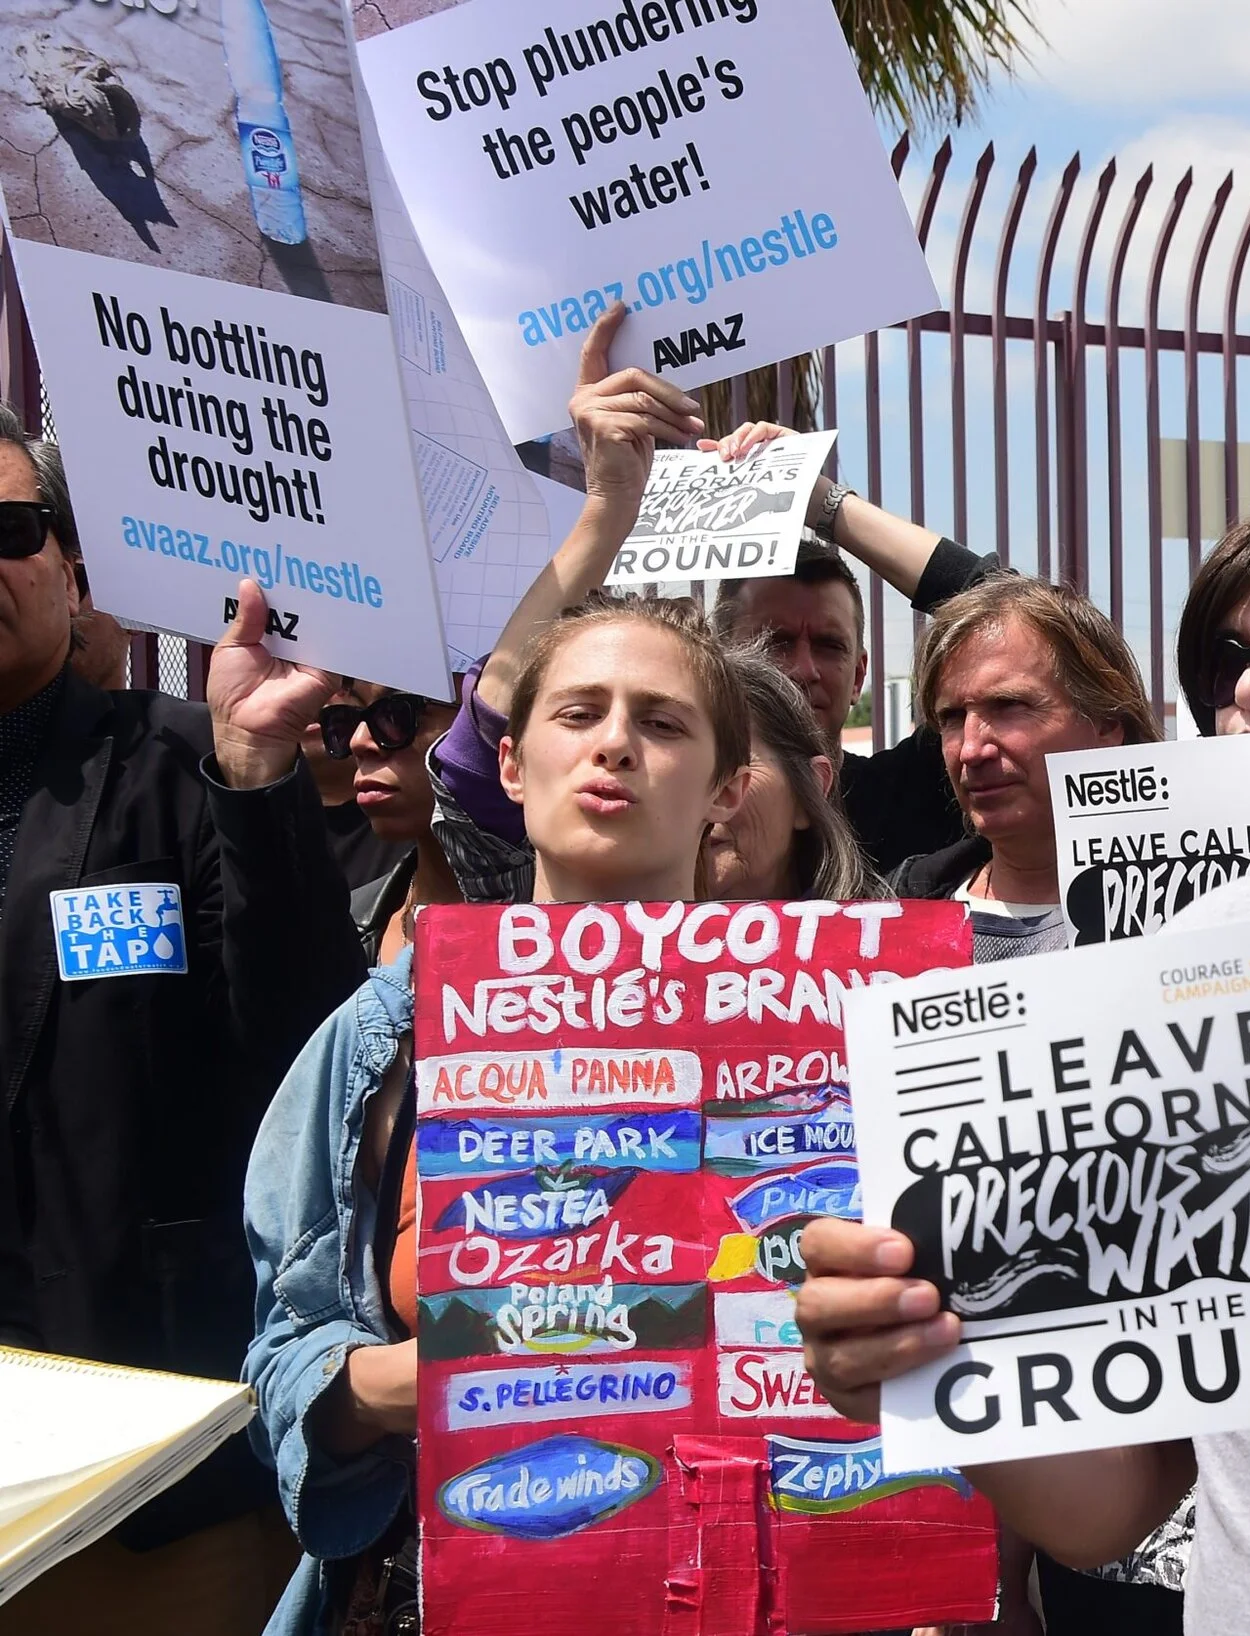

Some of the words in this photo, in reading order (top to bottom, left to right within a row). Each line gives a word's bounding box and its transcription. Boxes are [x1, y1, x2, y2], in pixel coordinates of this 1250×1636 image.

[417, 63, 517, 121] Stop
[523, 0, 757, 97] plundering
[482, 123, 557, 180] the
[561, 56, 744, 165] people's
[569, 142, 711, 230] water!
[518, 209, 839, 346] avaaz.org/nestle
[92, 291, 152, 357] No
[160, 306, 328, 407] bottling
[653, 313, 746, 374] AVAAZ
[117, 365, 249, 455] during
[262, 396, 332, 462] the
[148, 436, 325, 525] drought!
[648, 467, 799, 494] LIFORNIA'S
[660, 458, 766, 479] LEAVE
[654, 487, 757, 533] WATER
[121, 516, 383, 608] avaaz.org/nestle
[613, 541, 778, 575] ROUND!
[660, 536, 675, 545] IN
[681, 534, 708, 543] THE
[223, 597, 299, 641] AAZ
[1073, 833, 1167, 866] LEAVE
[64, 891, 142, 912] TAKE
[68, 909, 145, 929] BACK
[68, 927, 148, 944] THE
[69, 939, 149, 969] TAP
[499, 900, 904, 975] BOYCOTT
[1160, 958, 1243, 987] COURAGE
[442, 968, 685, 1044] Nestlé's
[704, 967, 952, 1030] BRAN
[433, 1060, 548, 1103] ACQUA
[571, 1057, 677, 1097] PANNA
[459, 1129, 560, 1163] DEER
[574, 1124, 678, 1161] PARK
[751, 1126, 795, 1156] ICE
[804, 1122, 856, 1150] MOU
[462, 1189, 612, 1234] NESTEA
[941, 1146, 1200, 1280] PRECIOUS
[449, 1221, 674, 1286] Ozarka
[510, 1275, 613, 1305] Poland
[496, 1303, 637, 1349] Spring
[1119, 1304, 1157, 1333] IN
[1171, 1293, 1247, 1326] THE
